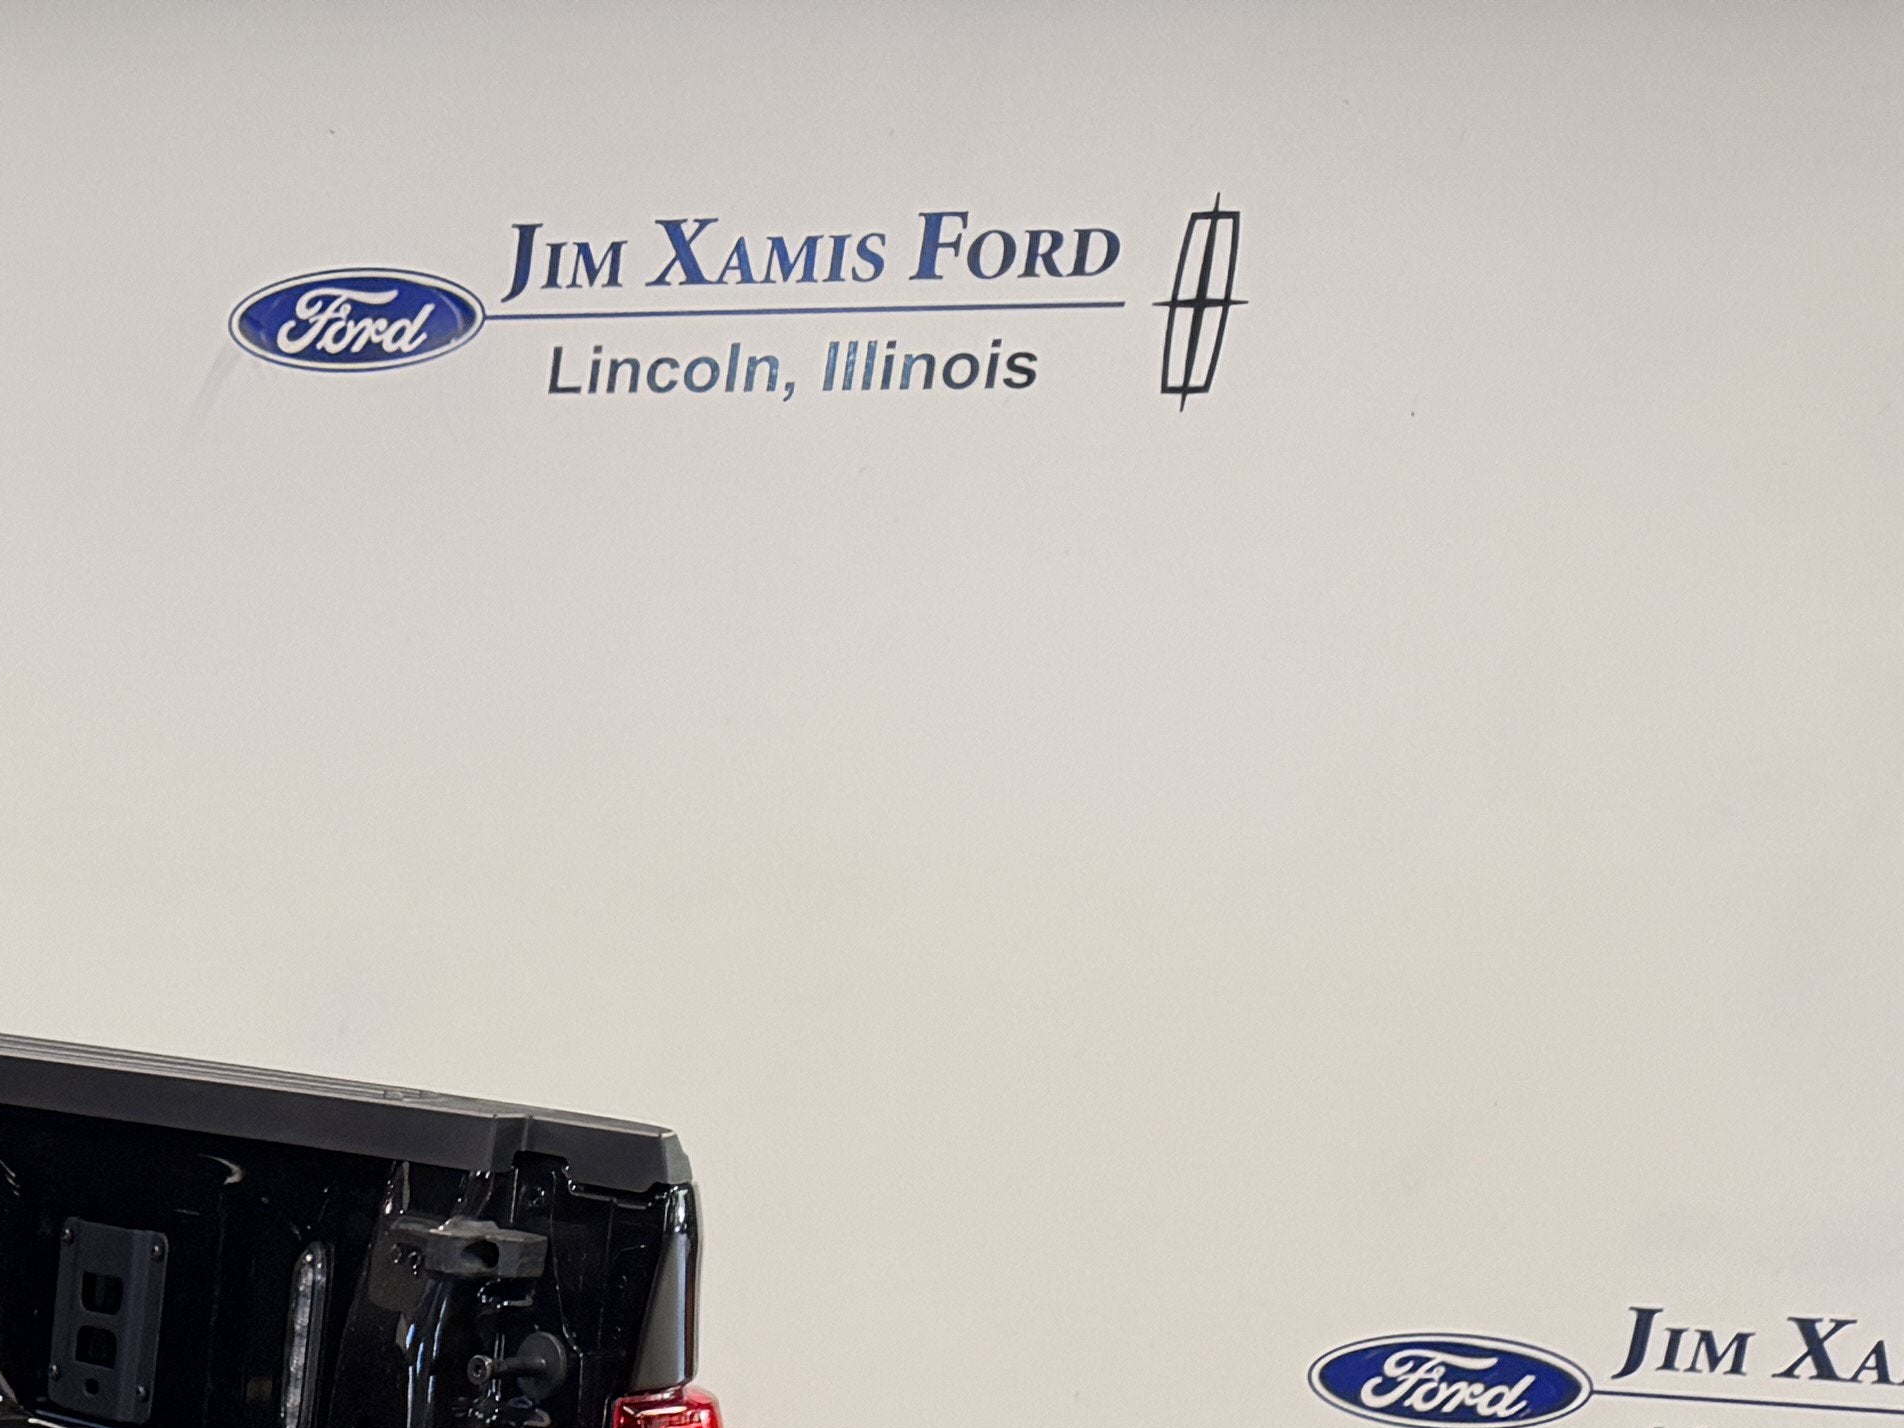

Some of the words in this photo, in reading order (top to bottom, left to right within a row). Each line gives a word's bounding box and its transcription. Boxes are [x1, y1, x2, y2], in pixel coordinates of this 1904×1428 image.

[500, 222, 629, 304] JIM
[645, 217, 886, 287] XAMIS
[908, 210, 1121, 281] FORD
[276, 286, 428, 357] Ford
[547, 342, 795, 403] Lincoln,
[822, 338, 1038, 391] Illinois
[1610, 1305, 1756, 1381] JIM
[1359, 1347, 1537, 1420] Ford
